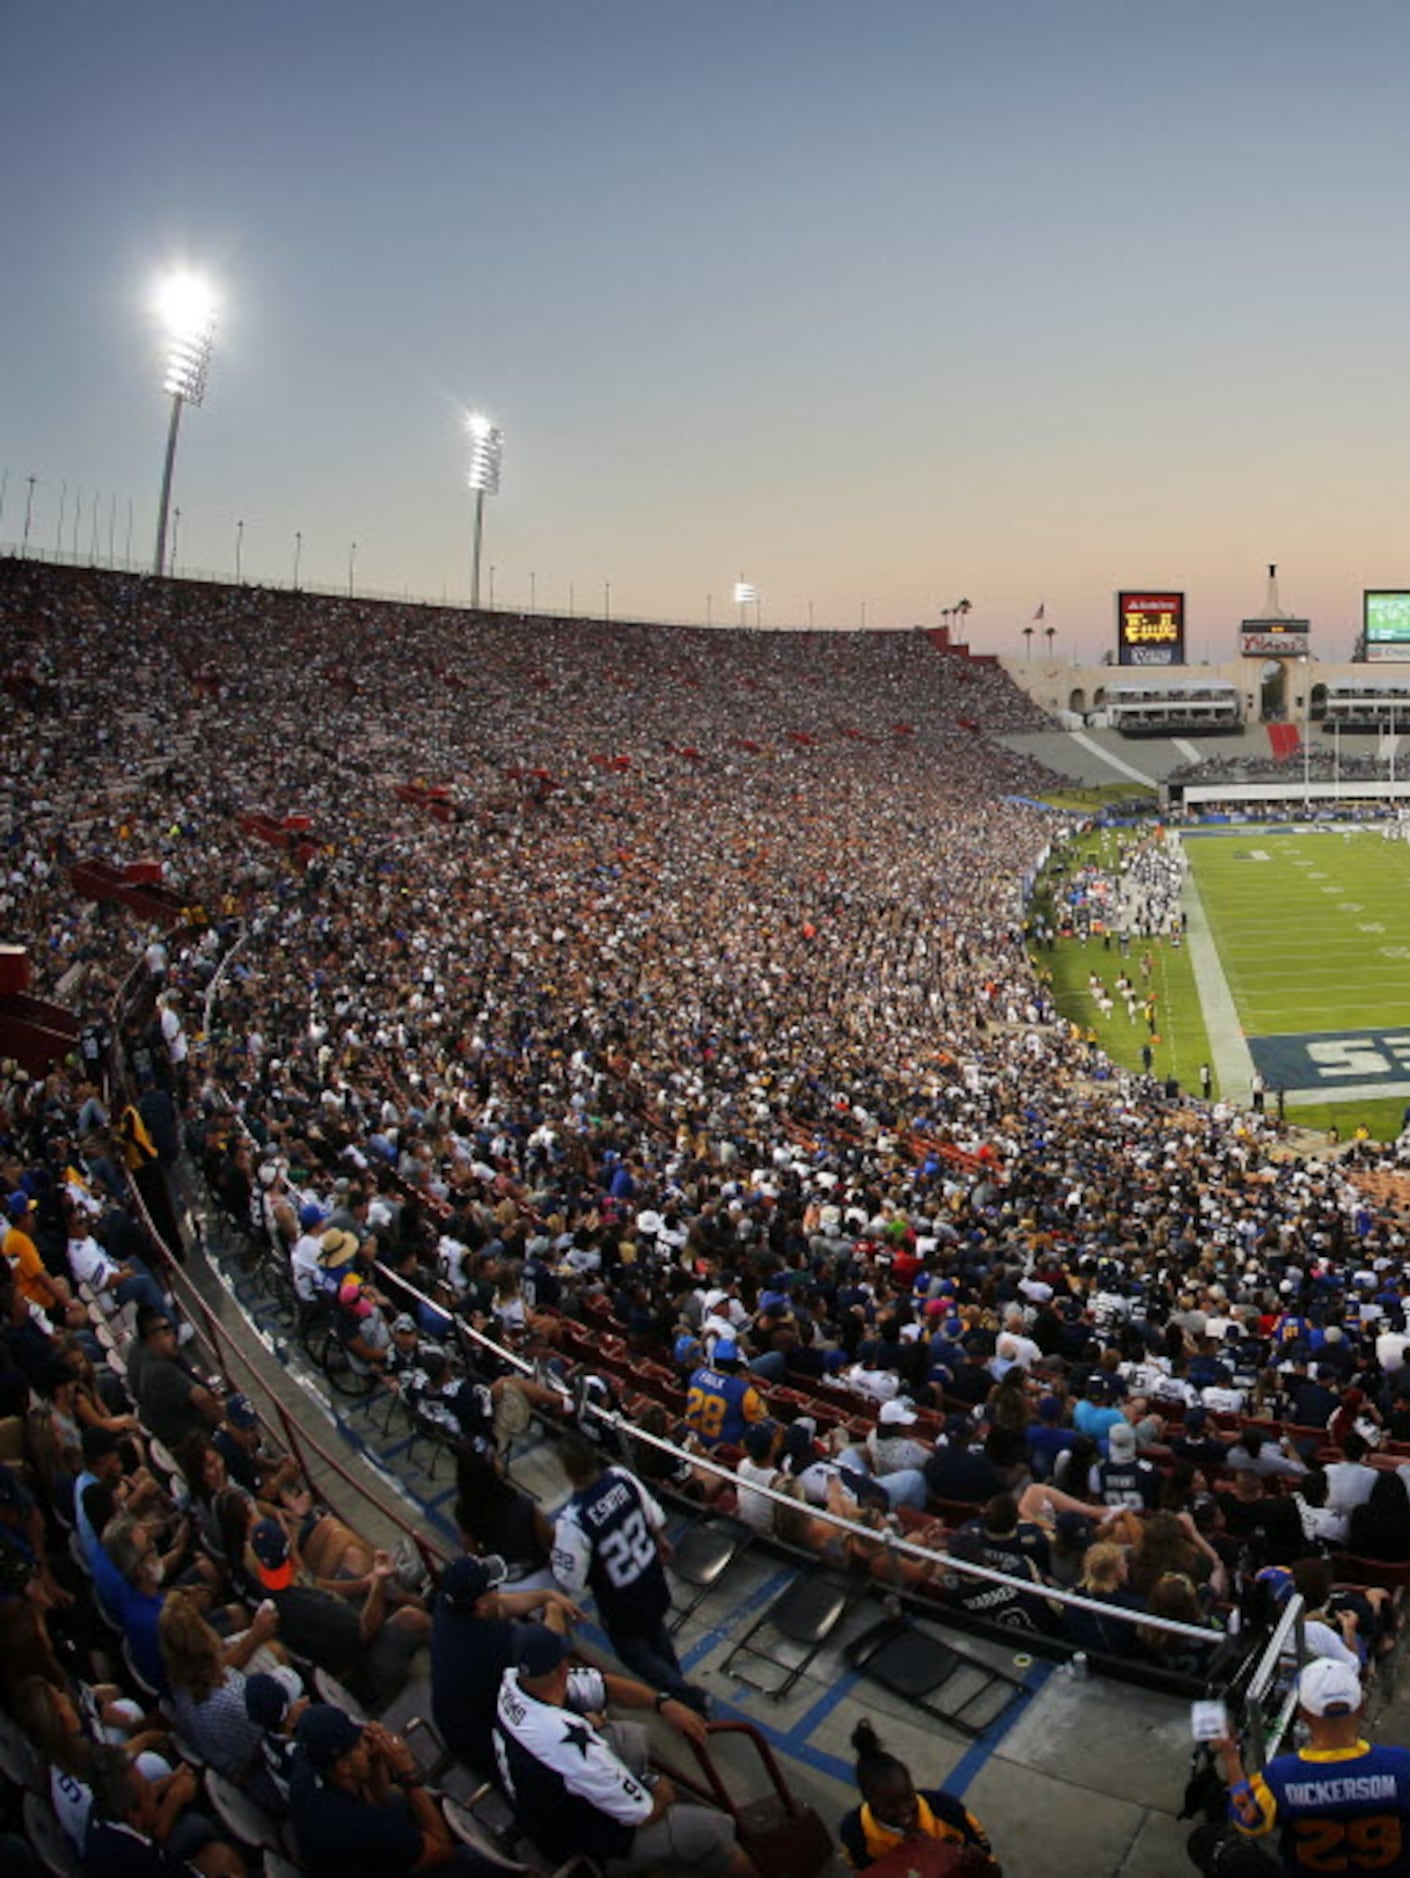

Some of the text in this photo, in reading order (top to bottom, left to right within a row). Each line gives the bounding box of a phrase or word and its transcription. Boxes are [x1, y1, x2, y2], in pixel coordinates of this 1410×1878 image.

[598, 1508, 656, 1589] 22
[1284, 1773, 1398, 1807] DICKERSON
[1294, 1813, 1404, 1874] 29
